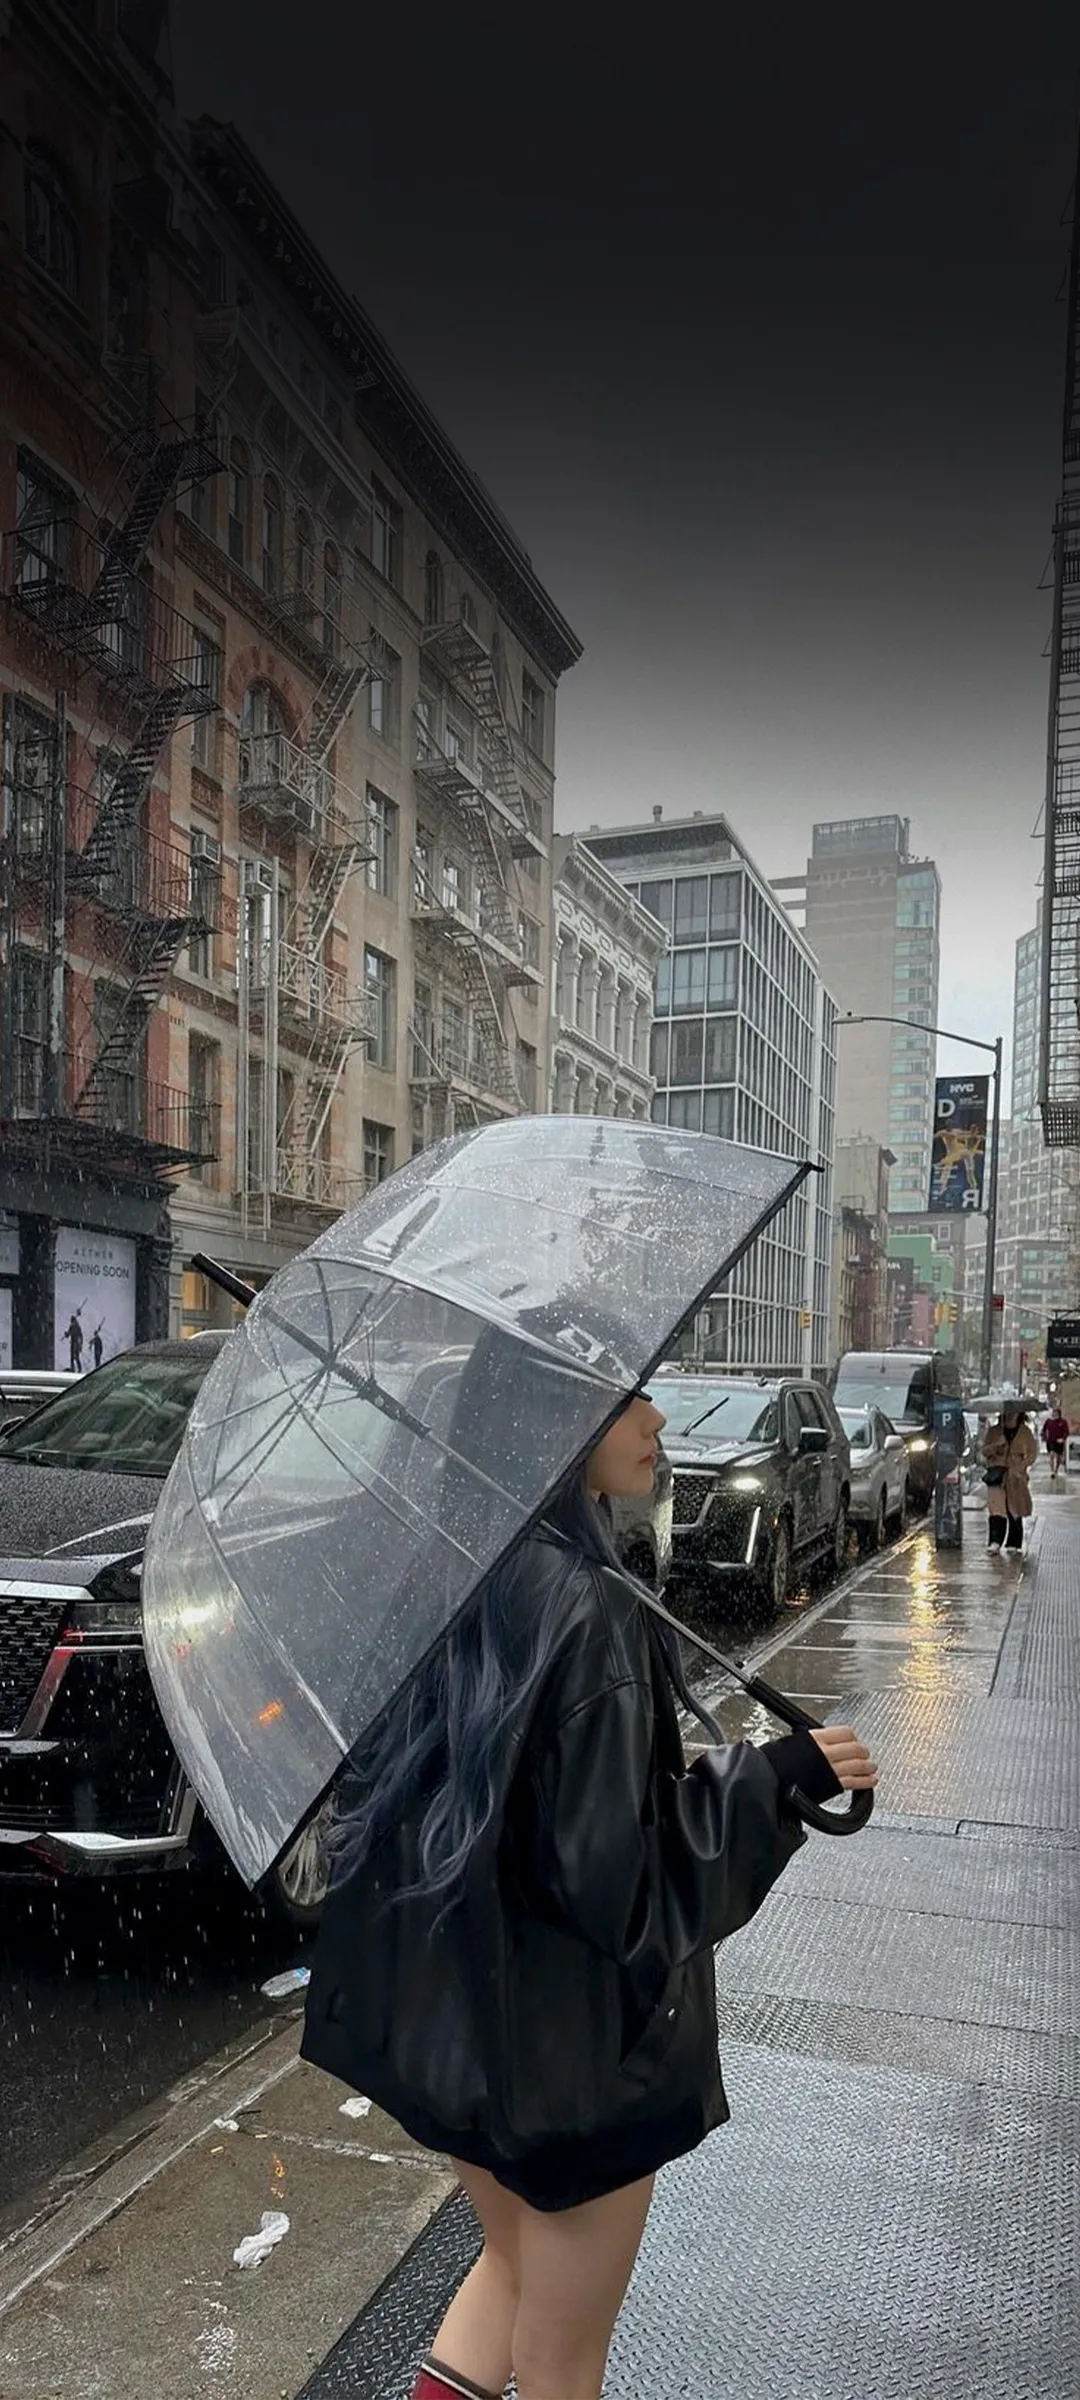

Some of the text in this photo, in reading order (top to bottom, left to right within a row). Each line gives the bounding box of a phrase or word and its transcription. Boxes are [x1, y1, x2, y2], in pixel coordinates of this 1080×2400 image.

[950, 1083, 974, 1094] NYC
[938, 1099, 955, 1117] D
[56, 1260, 129, 1278] OPENING SOON
[942, 1413, 952, 1426] P
